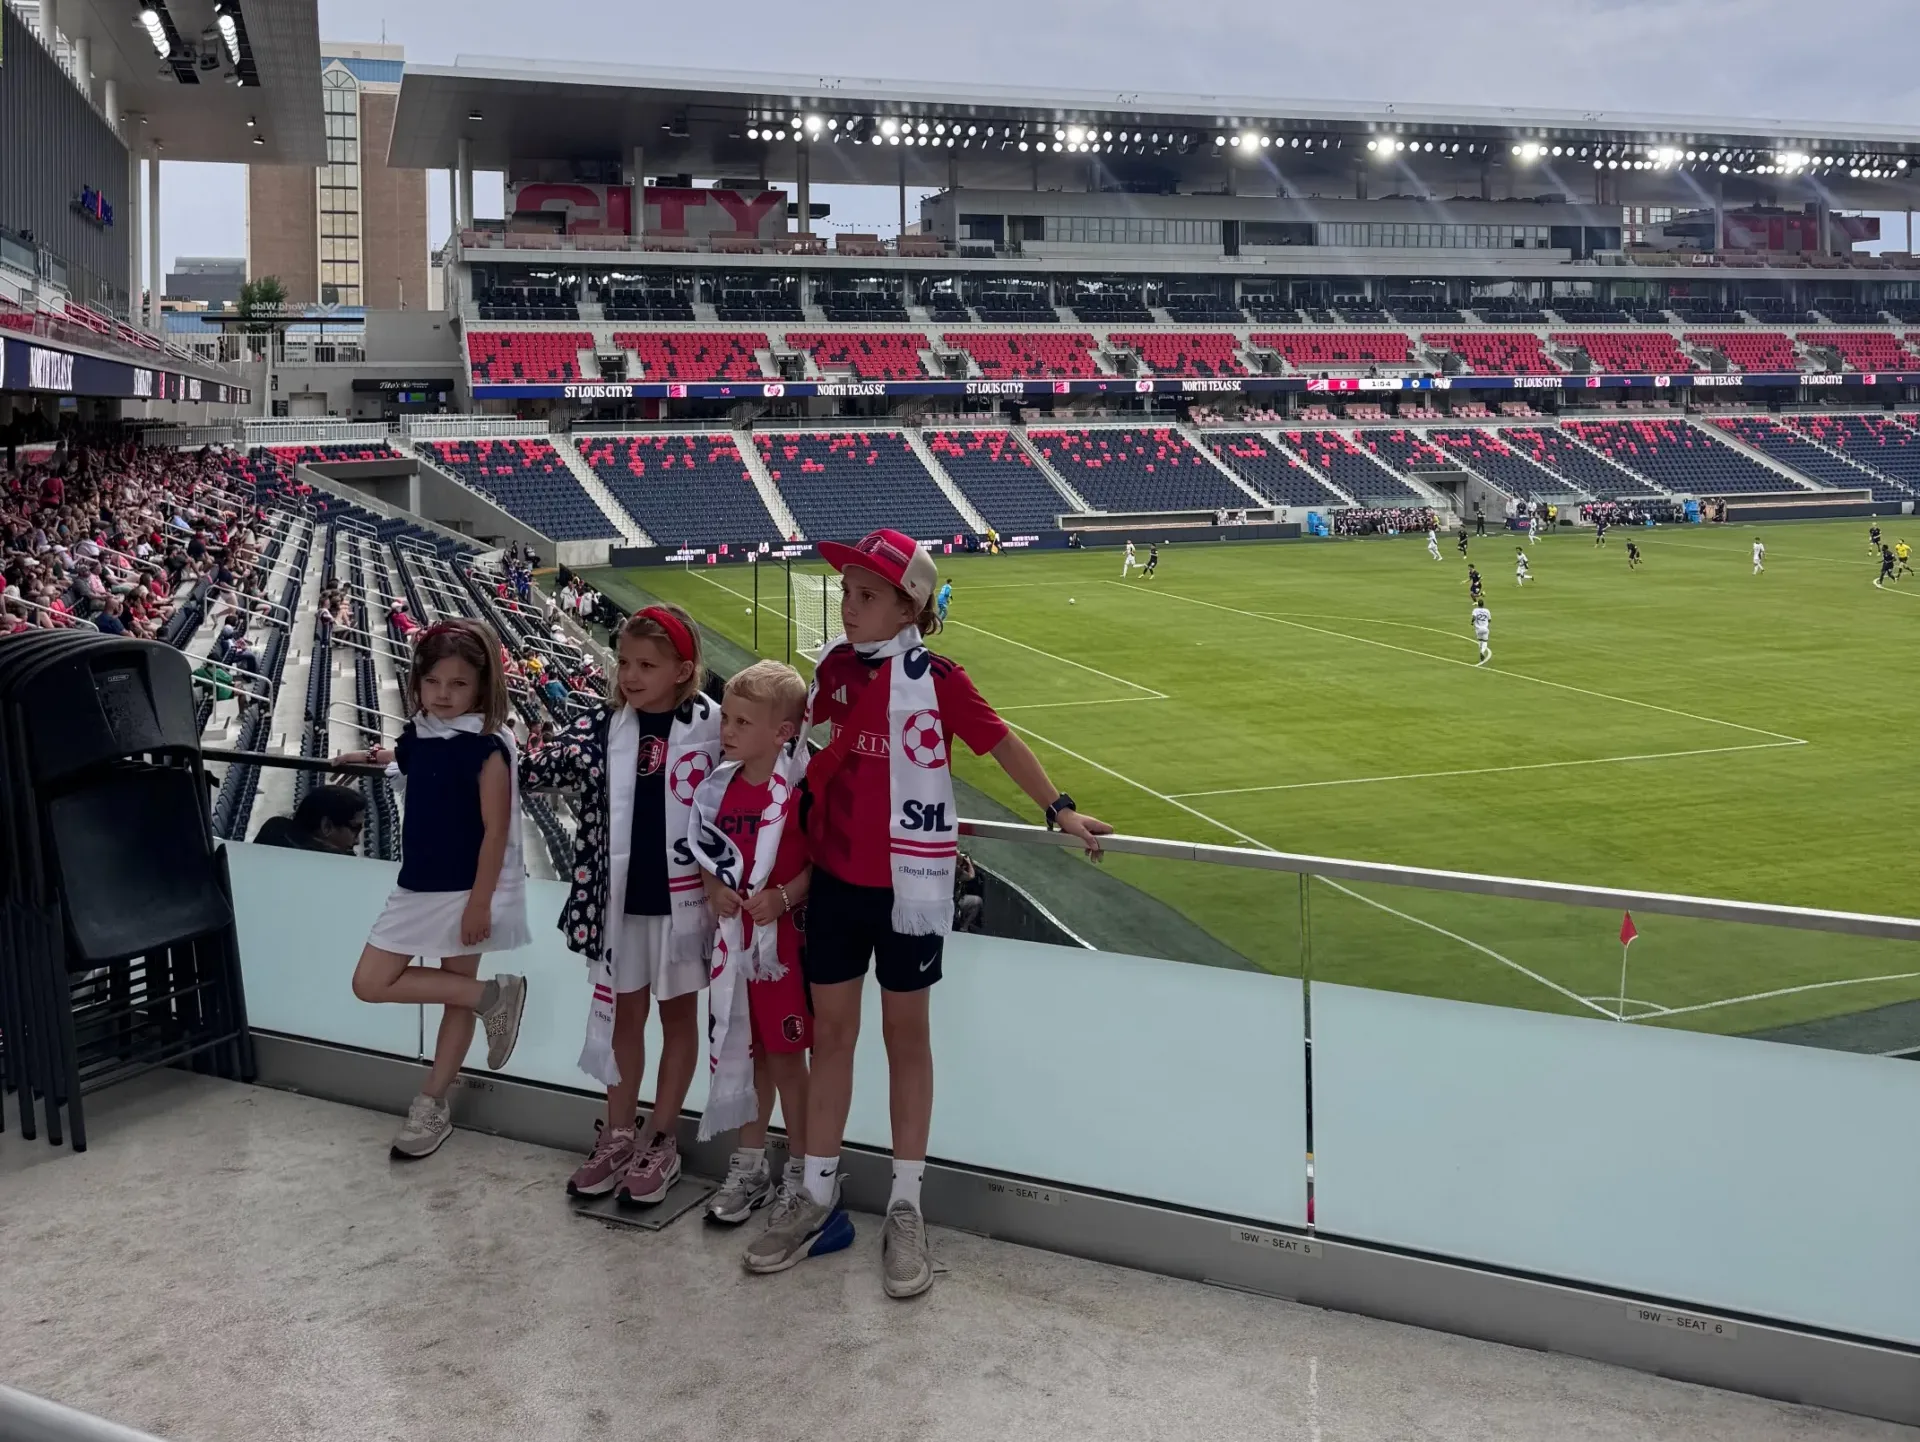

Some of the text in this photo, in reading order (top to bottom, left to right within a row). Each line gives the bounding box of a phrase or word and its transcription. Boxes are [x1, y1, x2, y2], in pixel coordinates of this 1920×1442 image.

[1182, 381, 1241, 391] NORTH TEXAS SC
[1514, 378, 1523, 387] ST
[1524, 378, 1542, 387] LOUIS
[1694, 376, 1742, 385] NORTH TEXAS SC
[564, 386, 633, 397] ST LOUIS CITY2
[817, 385, 885, 395] NORTH TEXAS SC
[966, 383, 1024, 394] ST LOUIS CITY2
[722, 815, 761, 835] CIT
[904, 866, 949, 877] Royal Banks
[489, 1084, 494, 1092] 2
[988, 1183, 1005, 1193] 19W
[1016, 1188, 1038, 1200] SEAT
[1044, 1194, 1050, 1202] 4
[1241, 1232, 1260, 1243] 19W
[1272, 1238, 1298, 1251] SEAT
[1304, 1244, 1311, 1254] 5
[1639, 1310, 1661, 1322] 19W
[1677, 1317, 1707, 1331] SEAT
[1715, 1324, 1723, 1334] 6
